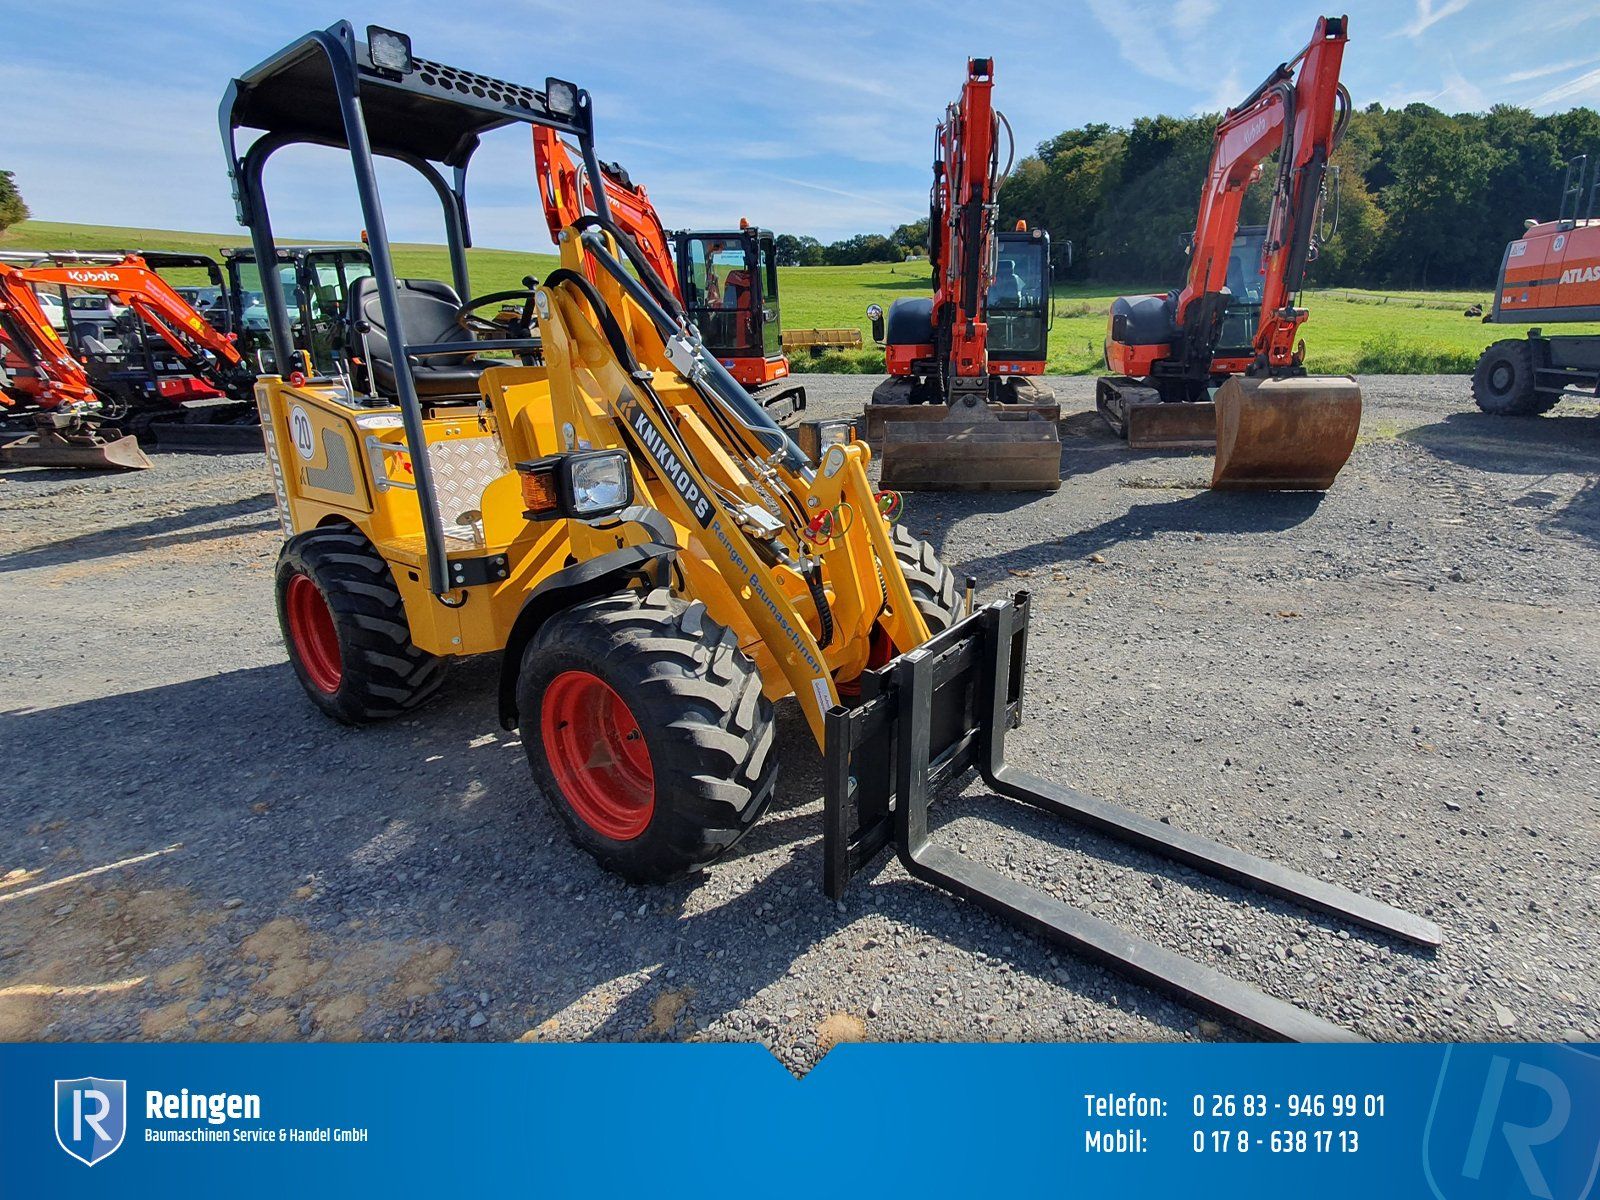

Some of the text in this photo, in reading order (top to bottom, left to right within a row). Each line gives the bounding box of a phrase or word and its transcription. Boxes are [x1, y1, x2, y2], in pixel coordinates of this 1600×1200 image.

[68, 270, 119, 282] Kubota
[1559, 265, 1600, 285] ATLAS
[294, 414, 312, 451] 20
[633, 412, 709, 522] KNIKMOPS
[266, 429, 295, 537] NIKMOPS
[711, 520, 821, 674] Reingen Baumaschinen
